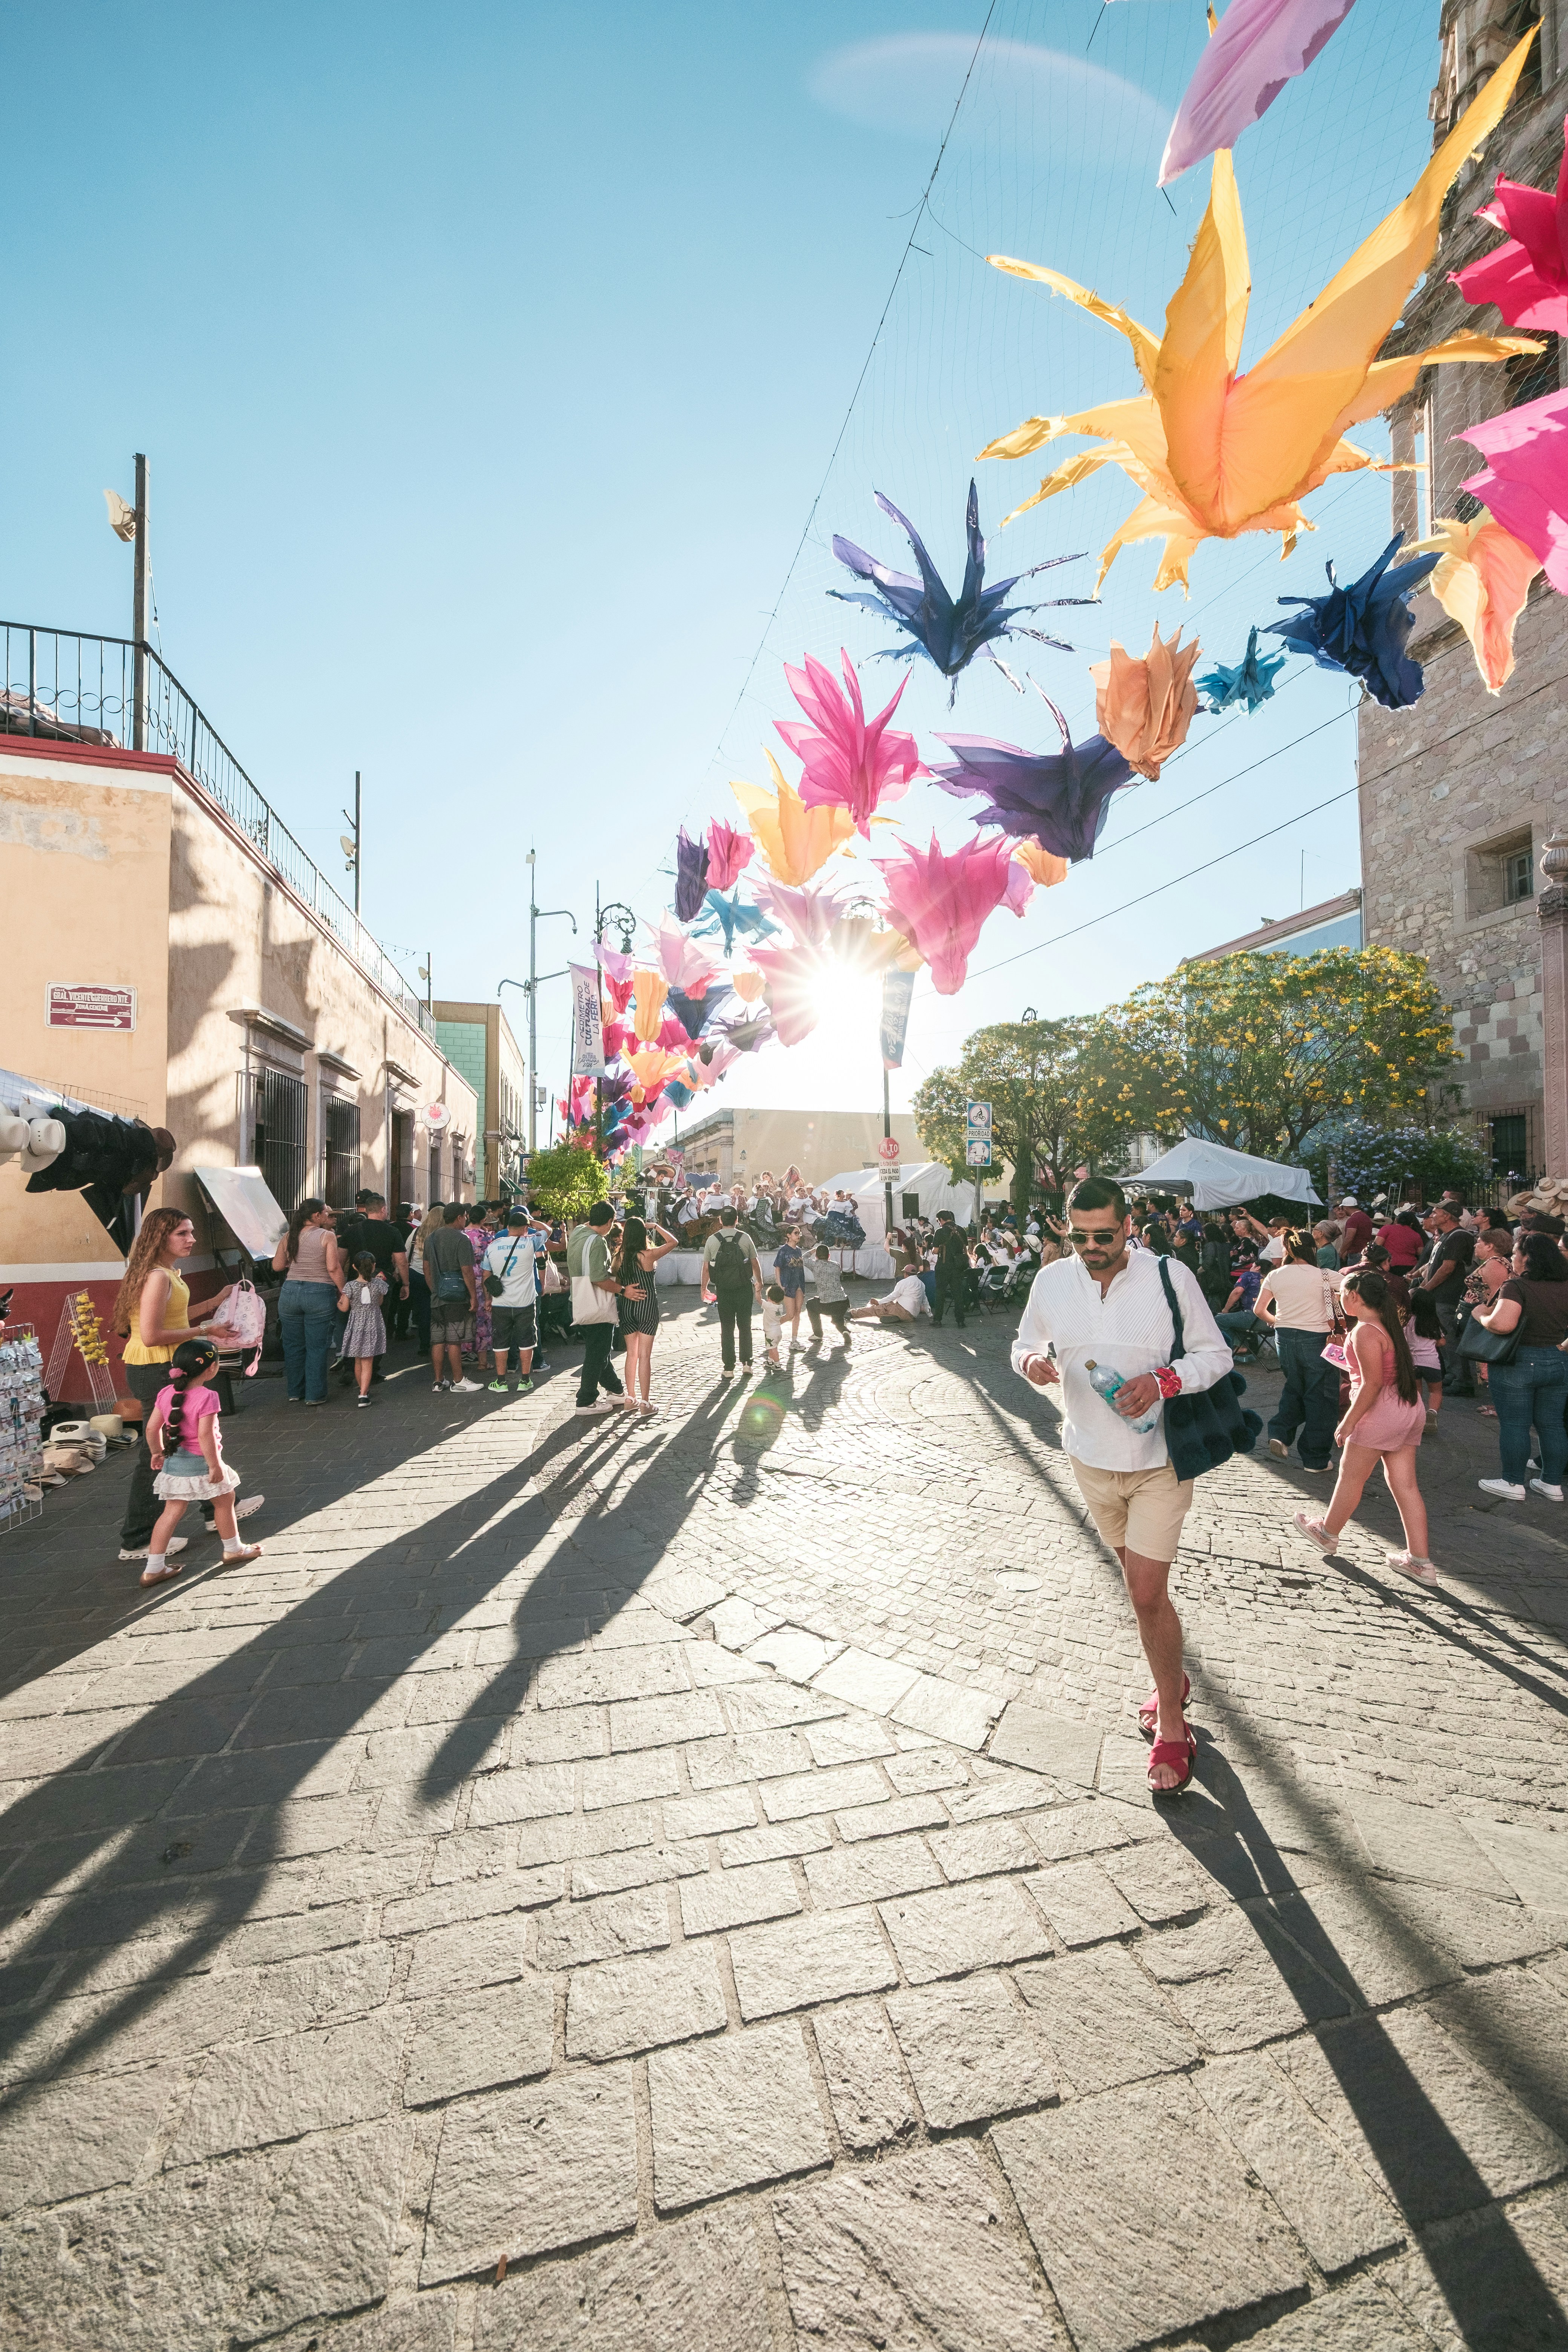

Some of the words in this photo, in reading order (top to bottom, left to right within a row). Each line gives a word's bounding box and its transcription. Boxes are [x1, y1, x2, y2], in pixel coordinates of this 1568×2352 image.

[584, 980, 590, 994] DE
[53, 991, 69, 1000] GRAL.
[68, 992, 91, 1001] VICENTE
[91, 993, 117, 1003] GUERRERO
[117, 994, 129, 1003] NTE.
[590, 994, 599, 1021] FERIA
[592, 1024, 599, 1034] LA
[897, 1017, 905, 1042] CULTURAL
[879, 1144, 898, 1153] ALTO
[504, 1256, 518, 1277] 7
